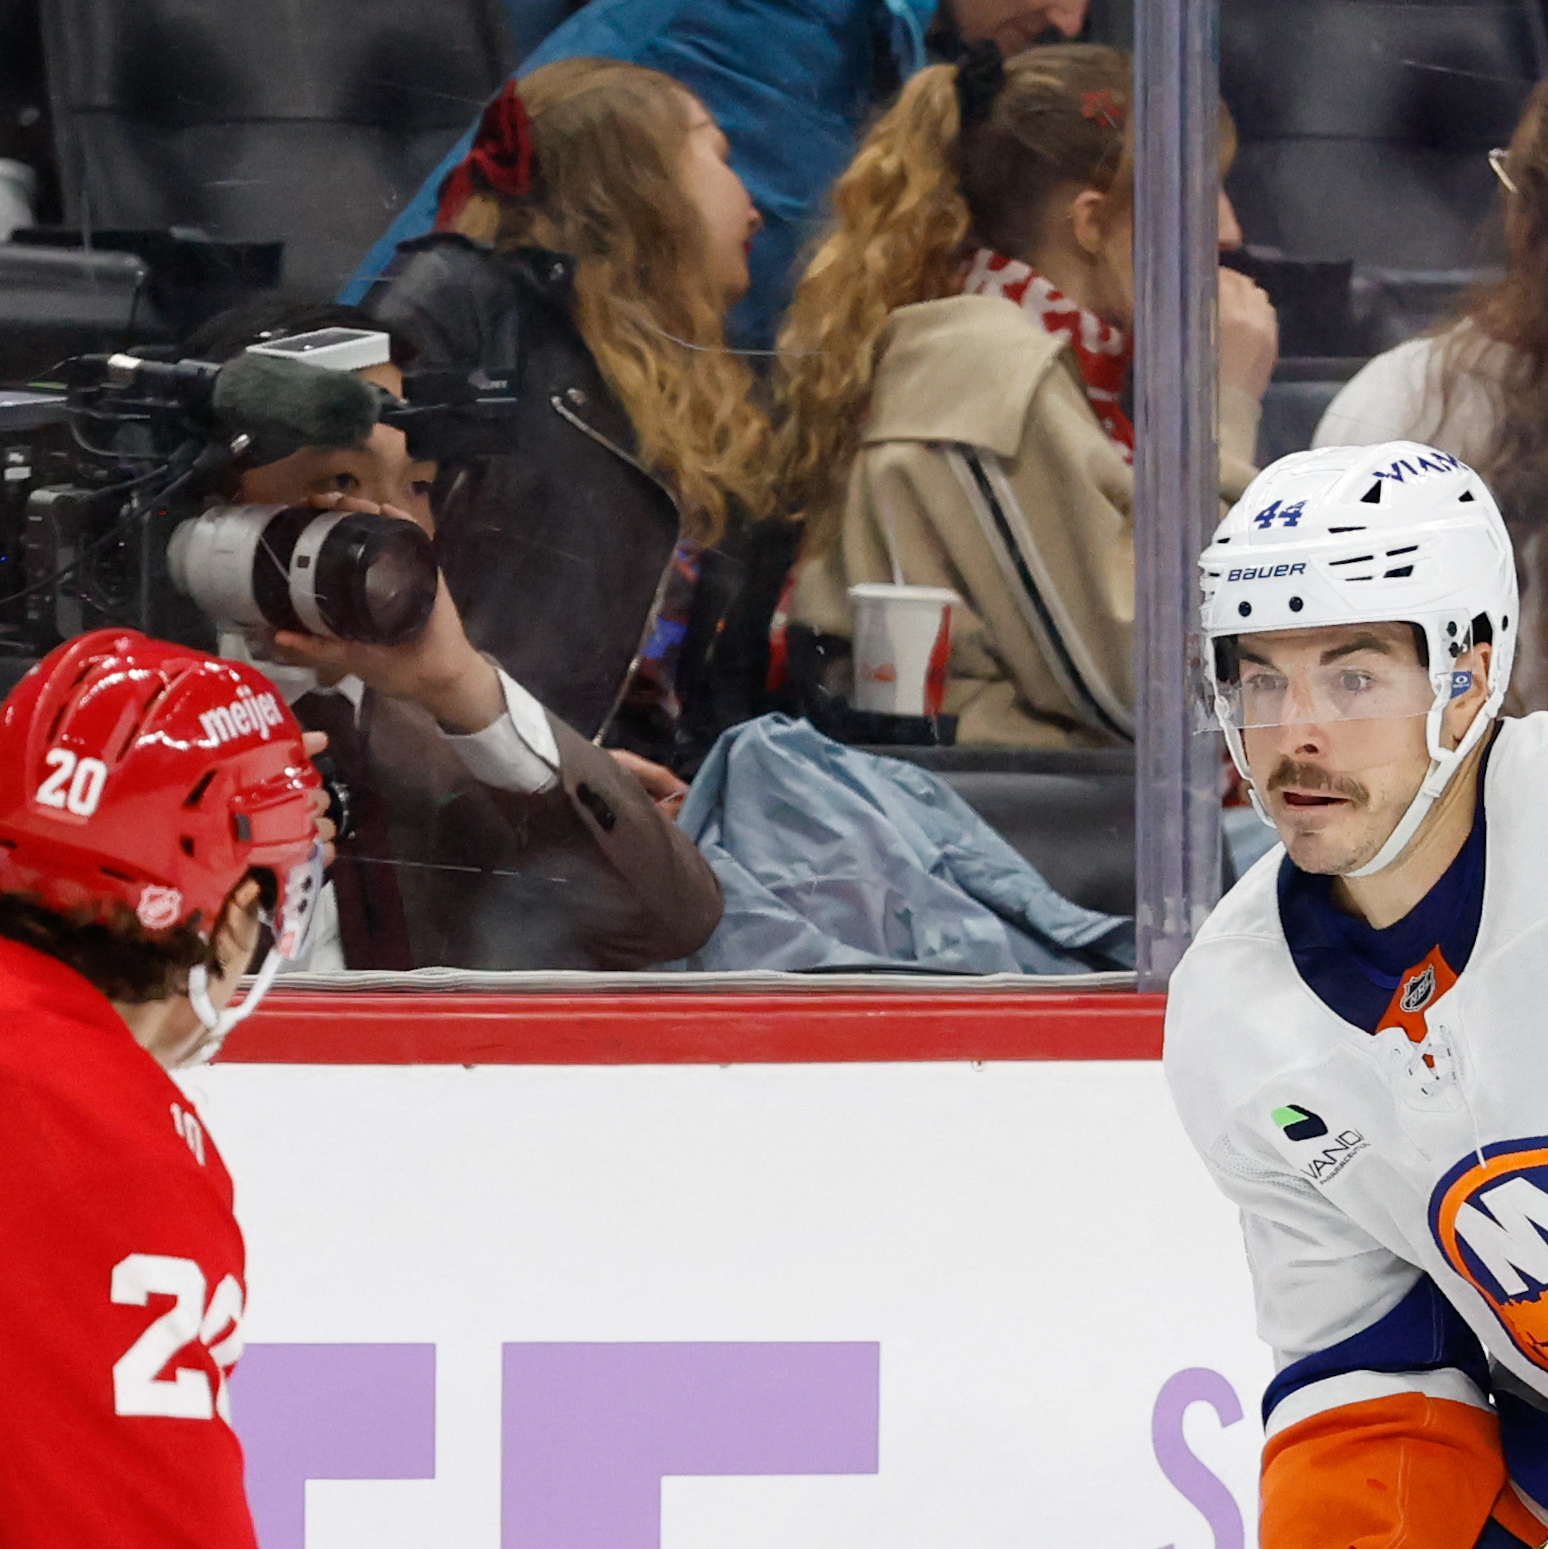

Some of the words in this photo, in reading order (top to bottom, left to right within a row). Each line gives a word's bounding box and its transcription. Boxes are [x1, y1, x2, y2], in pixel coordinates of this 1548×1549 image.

[1253, 499, 1308, 530] 44
[199, 685, 284, 741] meijer
[35, 748, 108, 817] 20
